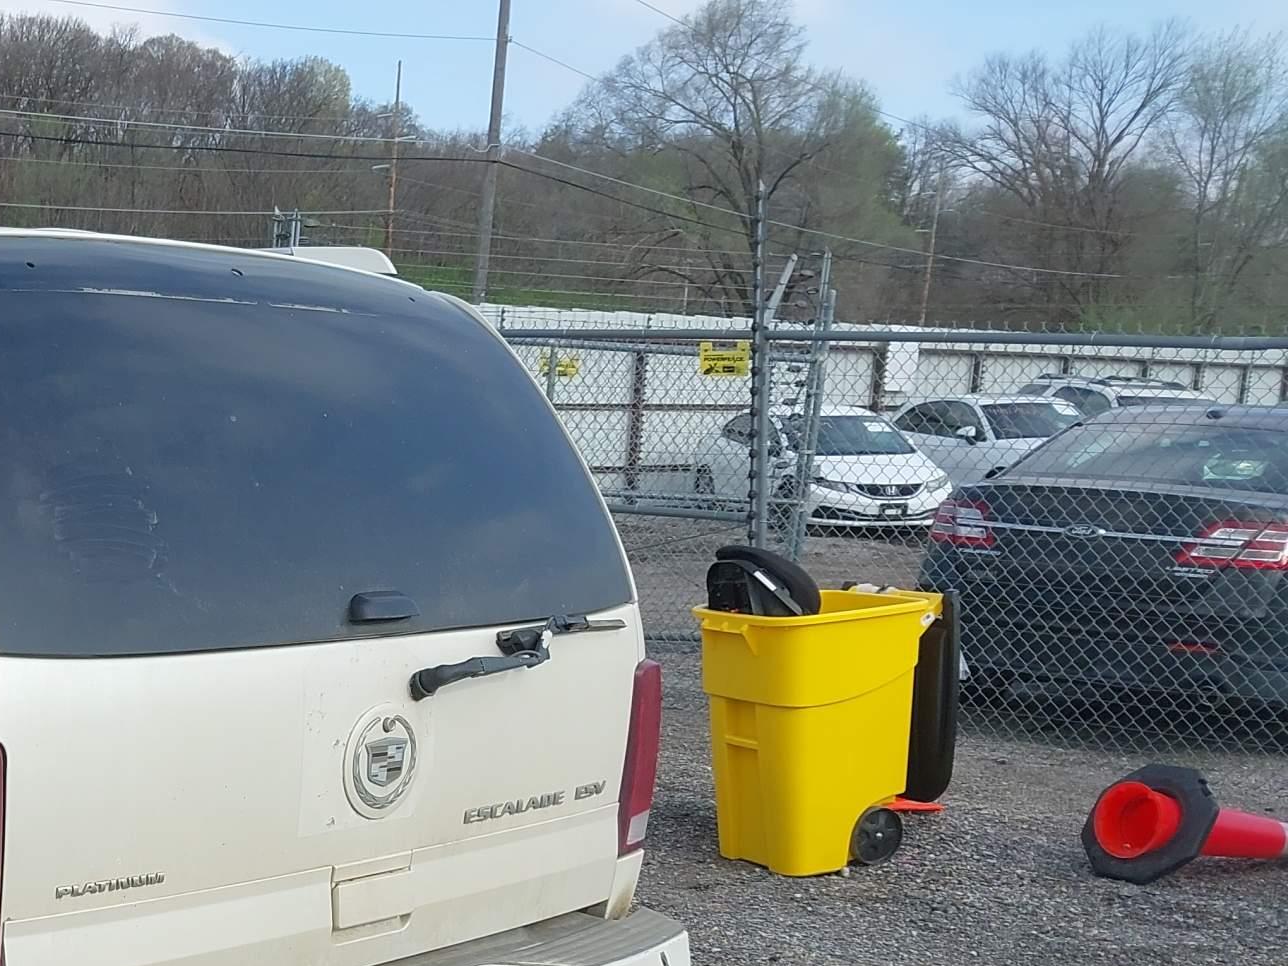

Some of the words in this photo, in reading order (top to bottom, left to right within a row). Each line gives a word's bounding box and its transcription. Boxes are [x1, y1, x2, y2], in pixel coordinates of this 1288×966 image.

[463, 791, 565, 824] ESCALADE
[574, 780, 606, 801] ESV
[55, 872, 165, 899] PLATINUM
